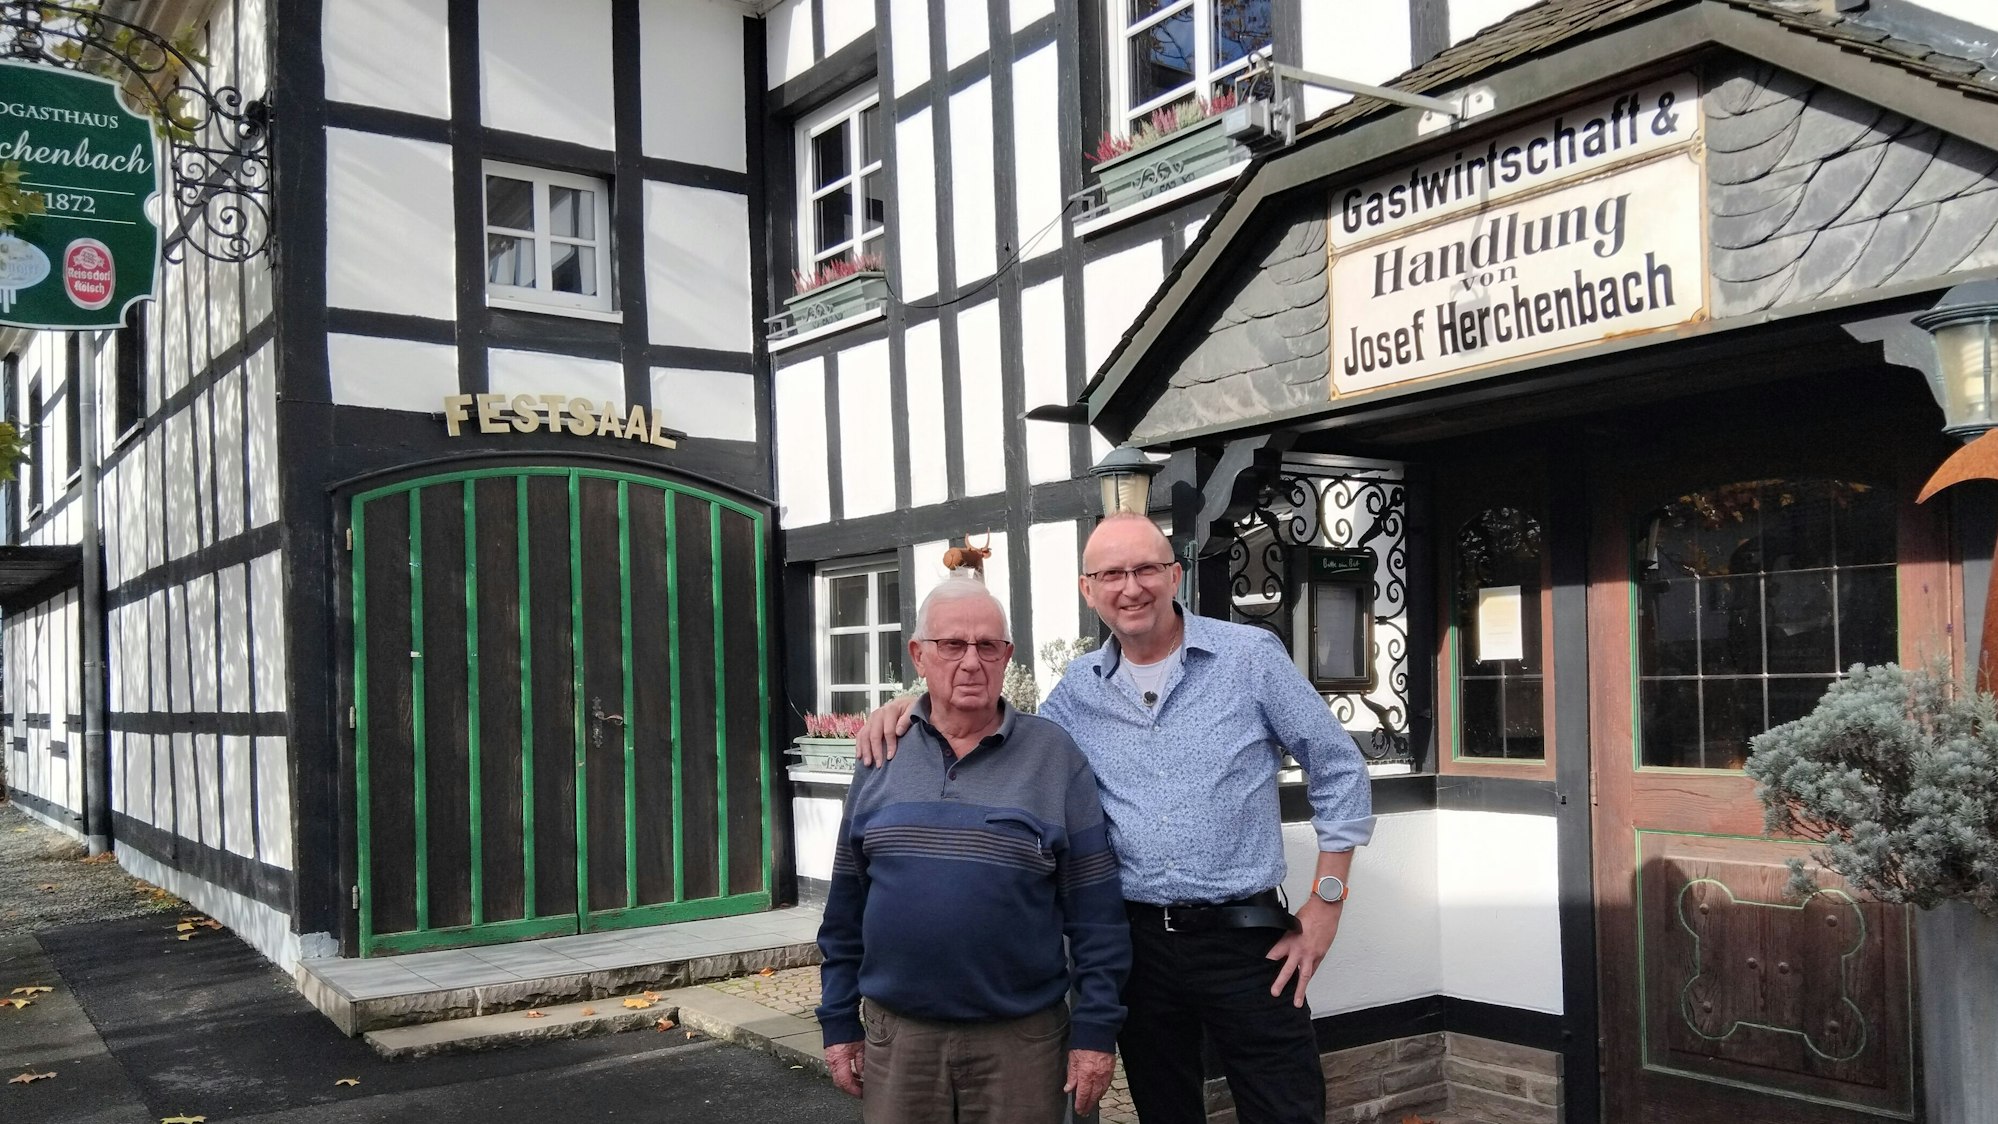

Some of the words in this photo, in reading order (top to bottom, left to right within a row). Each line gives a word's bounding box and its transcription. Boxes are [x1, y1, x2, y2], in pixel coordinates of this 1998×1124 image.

[1343, 92, 1640, 234] Gastwirtschaft
[1651, 91, 1678, 136] &
[44, 192, 96, 214] 1872
[1371, 192, 1632, 299] Handlung
[68, 267, 111, 281] Reissdorf
[74, 281, 105, 294] Kölsch
[1460, 266, 1518, 291] von
[1343, 310, 1425, 377] Josef
[1437, 252, 1675, 357] Herchenbach
[444, 394, 676, 450] FESTSAAL
